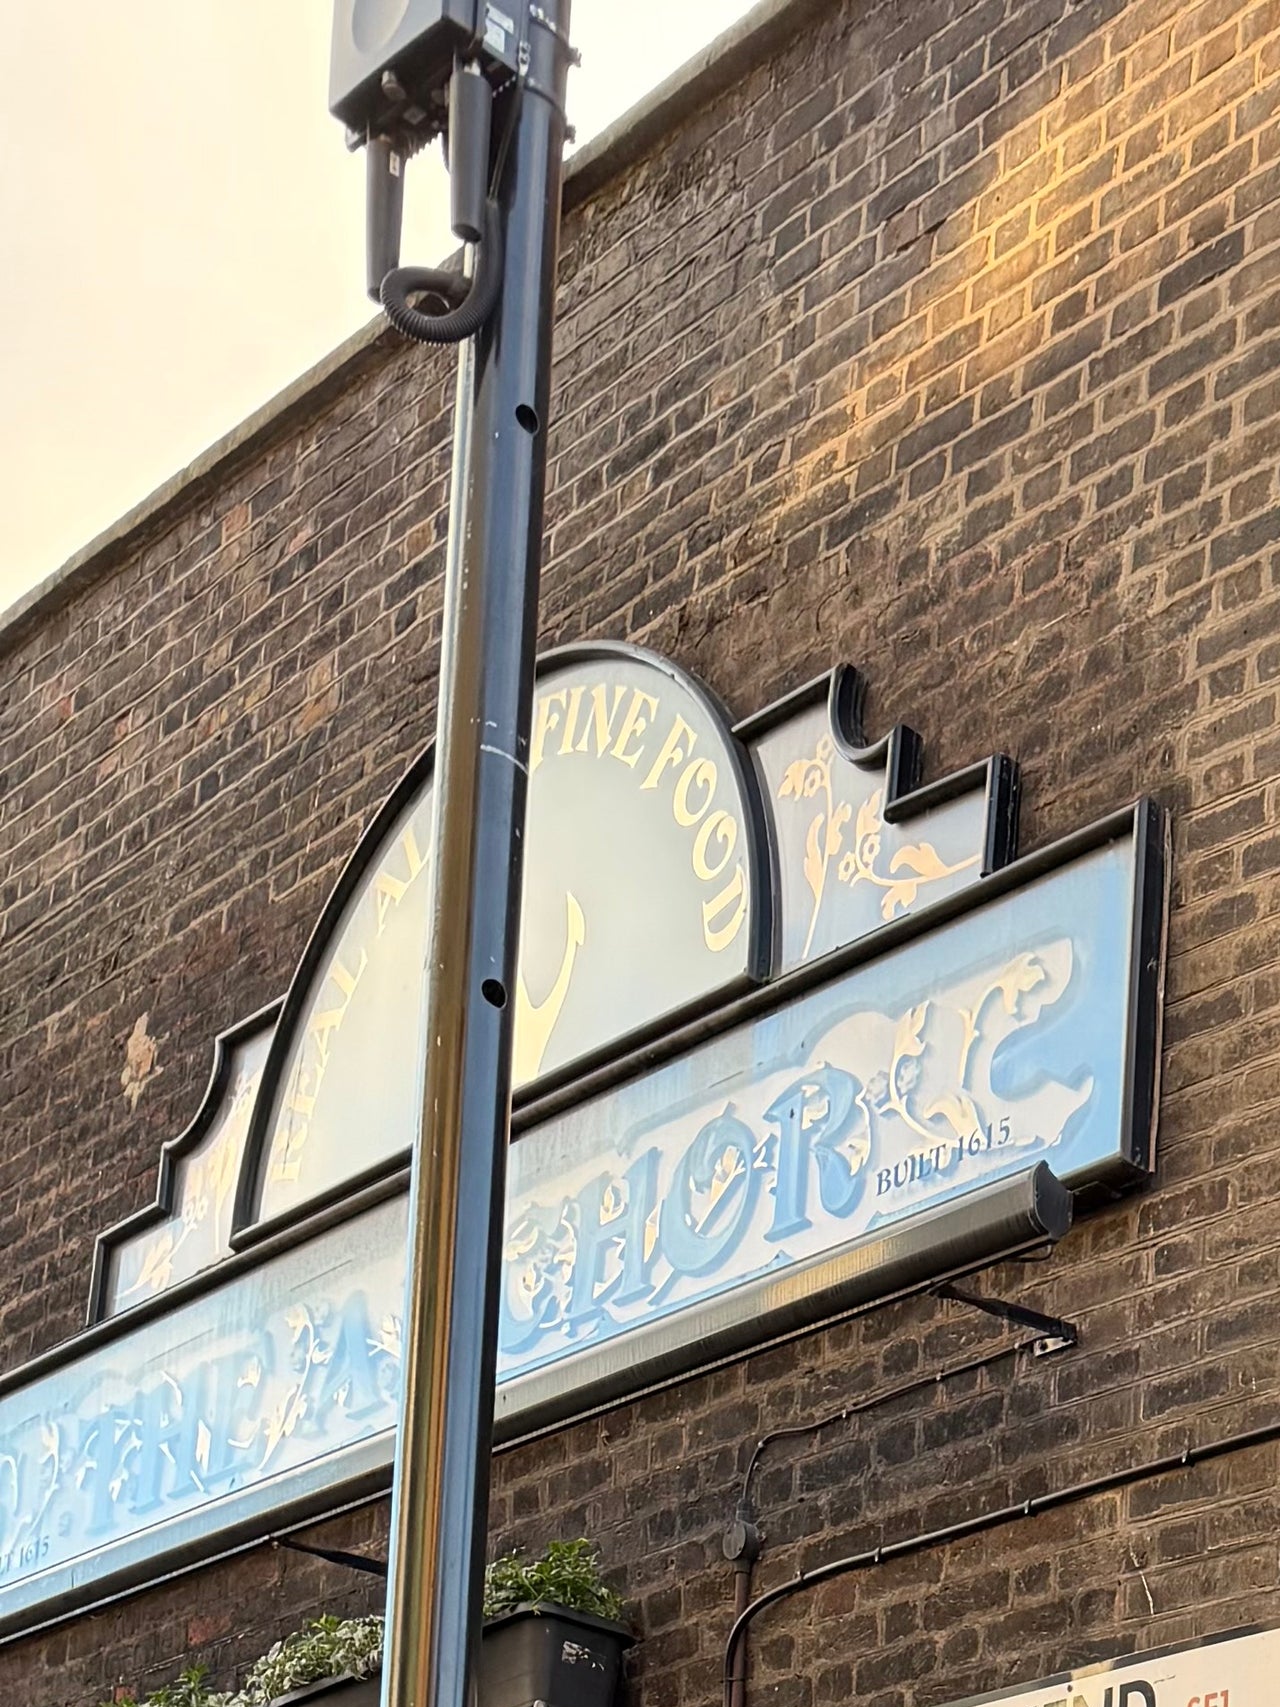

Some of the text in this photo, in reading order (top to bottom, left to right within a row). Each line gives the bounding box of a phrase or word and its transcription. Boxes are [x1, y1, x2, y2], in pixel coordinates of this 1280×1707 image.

[270, 947, 369, 1184] REAL
[530, 682, 661, 774] FINE
[640, 712, 749, 953] FOOD
[876, 1115, 1011, 1197] BUILT 1615
